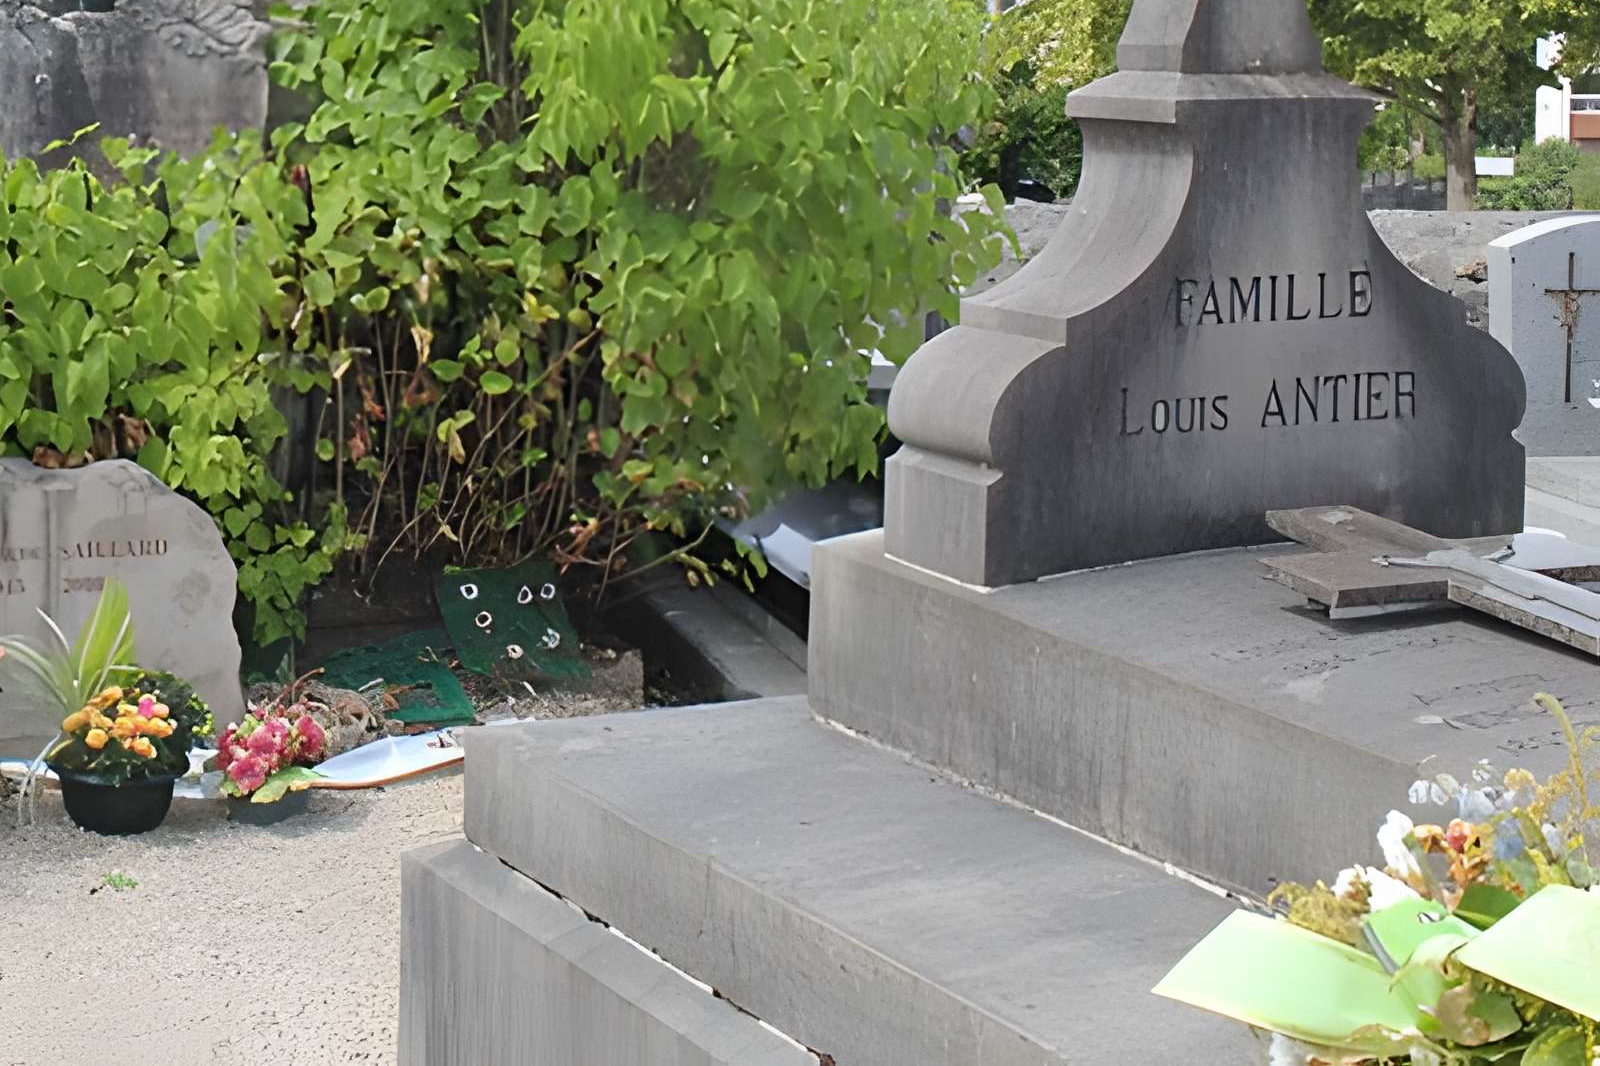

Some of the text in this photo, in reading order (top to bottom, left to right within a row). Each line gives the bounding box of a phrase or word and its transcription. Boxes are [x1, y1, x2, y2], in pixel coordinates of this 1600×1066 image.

[1174, 270, 1373, 327] FAMILLE
[1120, 371, 1416, 436] LOUIS ANTIER
